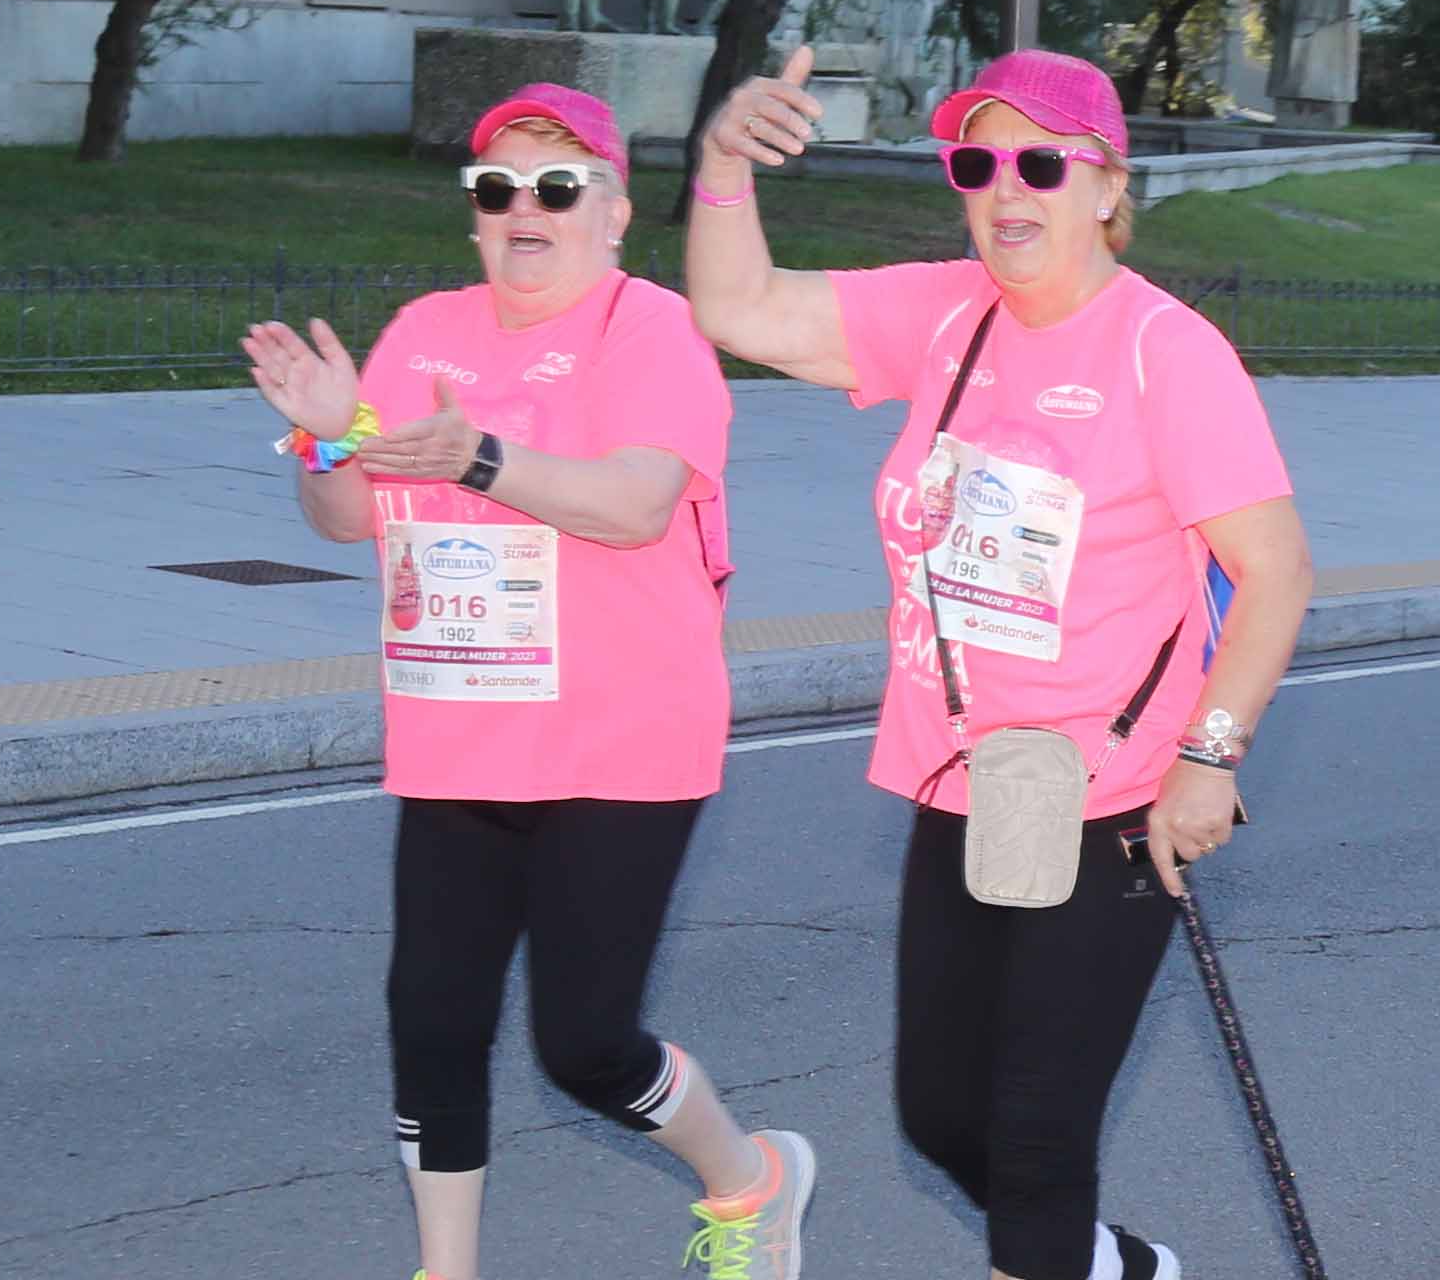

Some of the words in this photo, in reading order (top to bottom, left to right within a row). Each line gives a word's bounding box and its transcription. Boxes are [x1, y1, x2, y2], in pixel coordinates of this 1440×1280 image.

[425, 554, 492, 570] ASTURIANA
[428, 594, 487, 619] 016
[438, 627, 476, 642] 1902
[979, 620, 1048, 644] Santander
[481, 674, 542, 689] Santander
